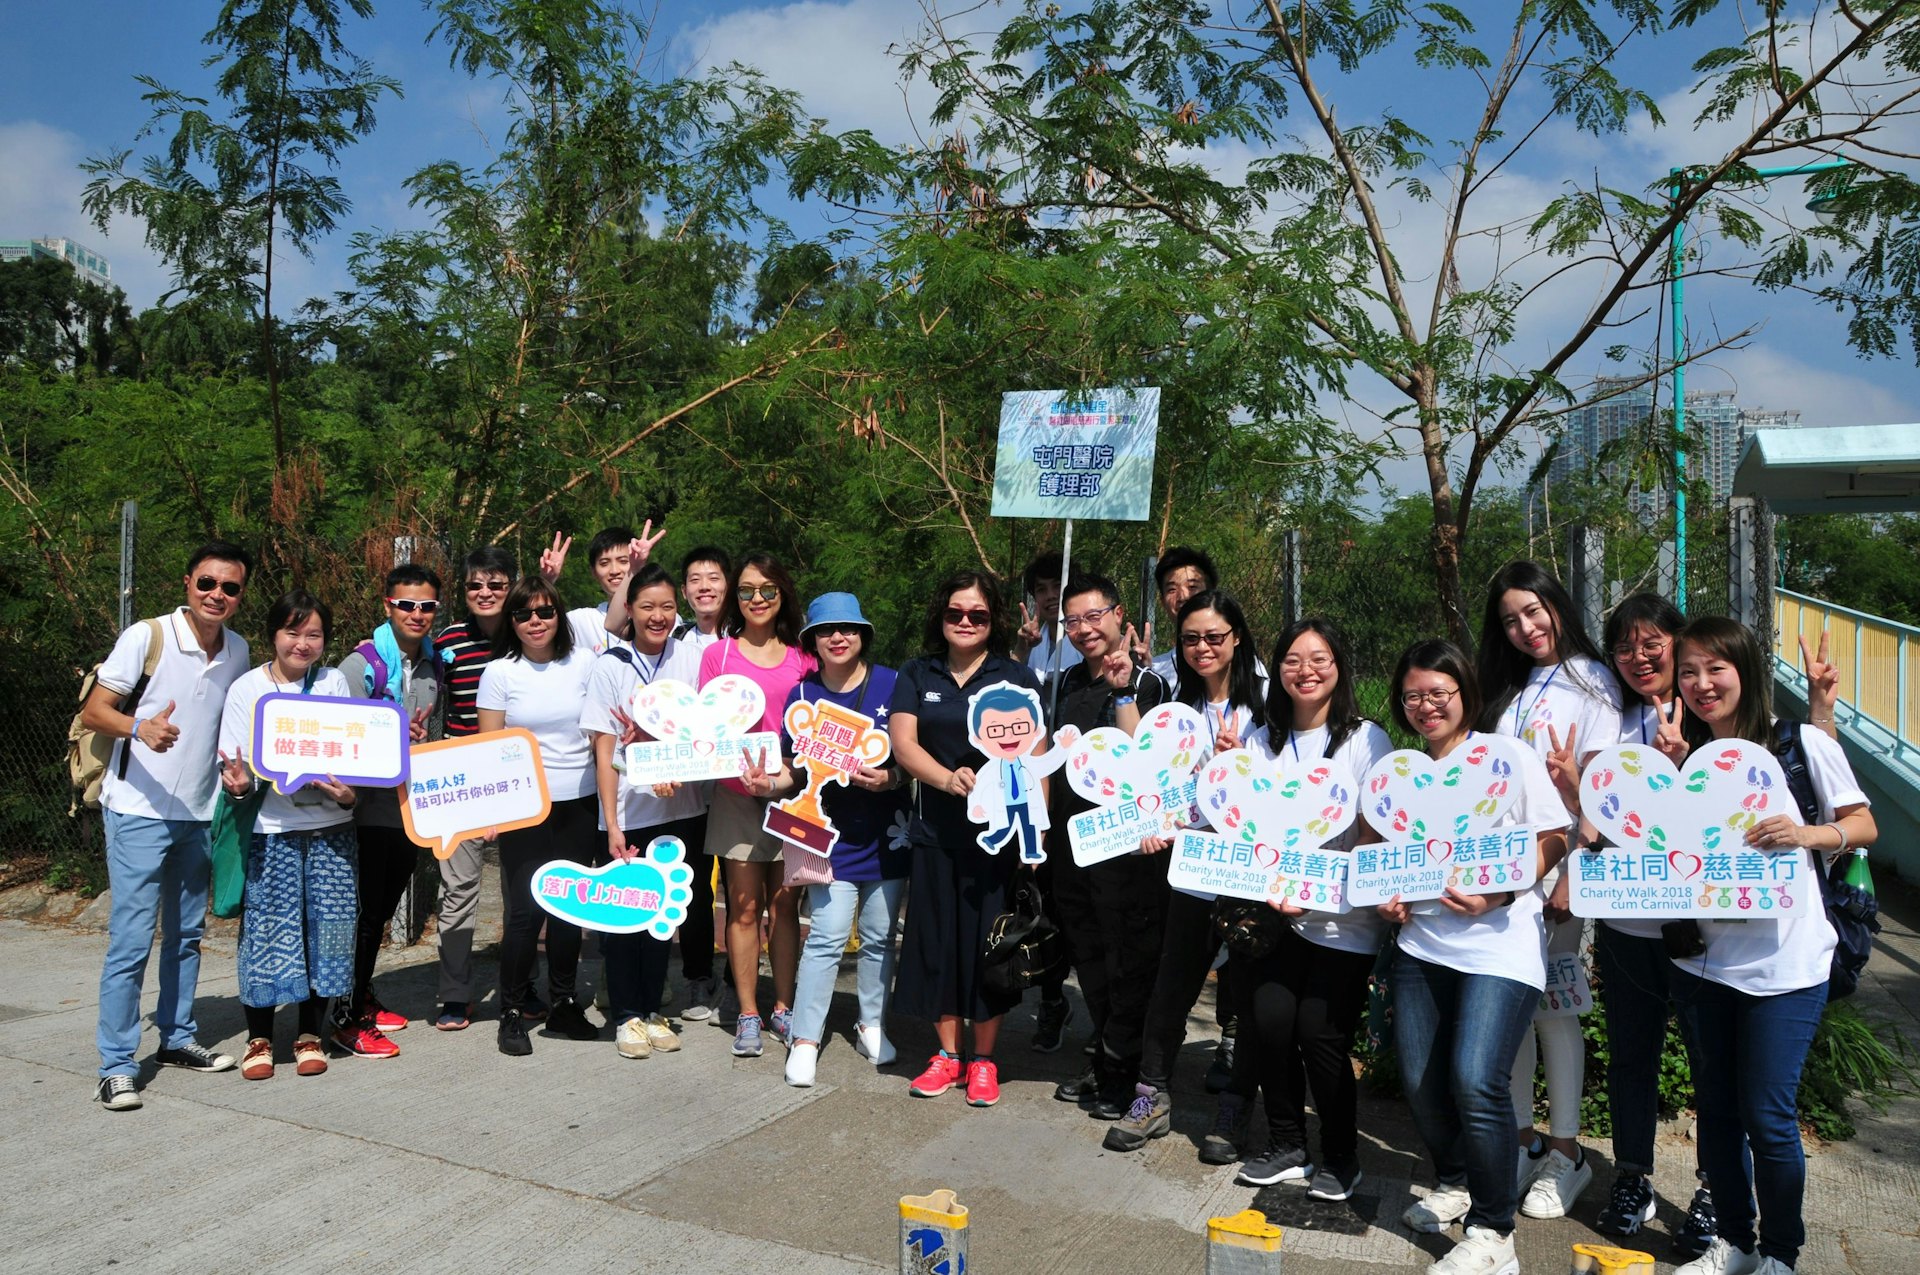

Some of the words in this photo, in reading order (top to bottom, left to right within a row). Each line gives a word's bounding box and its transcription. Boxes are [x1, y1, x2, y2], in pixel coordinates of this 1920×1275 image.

[1033, 445, 1114, 469] 屯門醫院
[1039, 473, 1101, 497] 護理部
[275, 717, 366, 739] 我哋一齊
[819, 720, 854, 748] 阿媽
[633, 742, 693, 763] 醫社同
[634, 764, 664, 776] Charity
[666, 762, 686, 773] Walk
[688, 760, 710, 770] 2018
[676, 768, 710, 778] Carnival
[412, 773, 467, 794] 為病人好
[1075, 801, 1139, 839] 醫社同
[1079, 837, 1111, 851] Charity
[1112, 828, 1135, 840] Walk
[1137, 818, 1158, 833] 2018
[1103, 842, 1123, 853] cum
[1182, 835, 1255, 867] 醫社同
[1278, 849, 1350, 880] 慈善行
[1358, 844, 1426, 874] 醫社同
[1453, 830, 1529, 863] 慈善行
[1178, 862, 1214, 877] Charity
[1215, 868, 1239, 880] Walk
[1241, 871, 1267, 883] 2018
[1579, 854, 1668, 881] 醫社同
[1703, 853, 1798, 881] 慈善行
[1201, 877, 1222, 885] cum
[1224, 880, 1264, 894] Carnival
[1356, 876, 1390, 889] Charity
[1391, 872, 1416, 884] Walk
[1419, 870, 1443, 882] 2018
[1378, 887, 1399, 896] cum
[1402, 882, 1442, 894] Carnival
[1580, 887, 1623, 902] Charity
[1627, 887, 1657, 898] Walk
[1661, 887, 1692, 898] 2018
[1611, 900, 1638, 910] cum
[1641, 898, 1692, 909] Carnival
